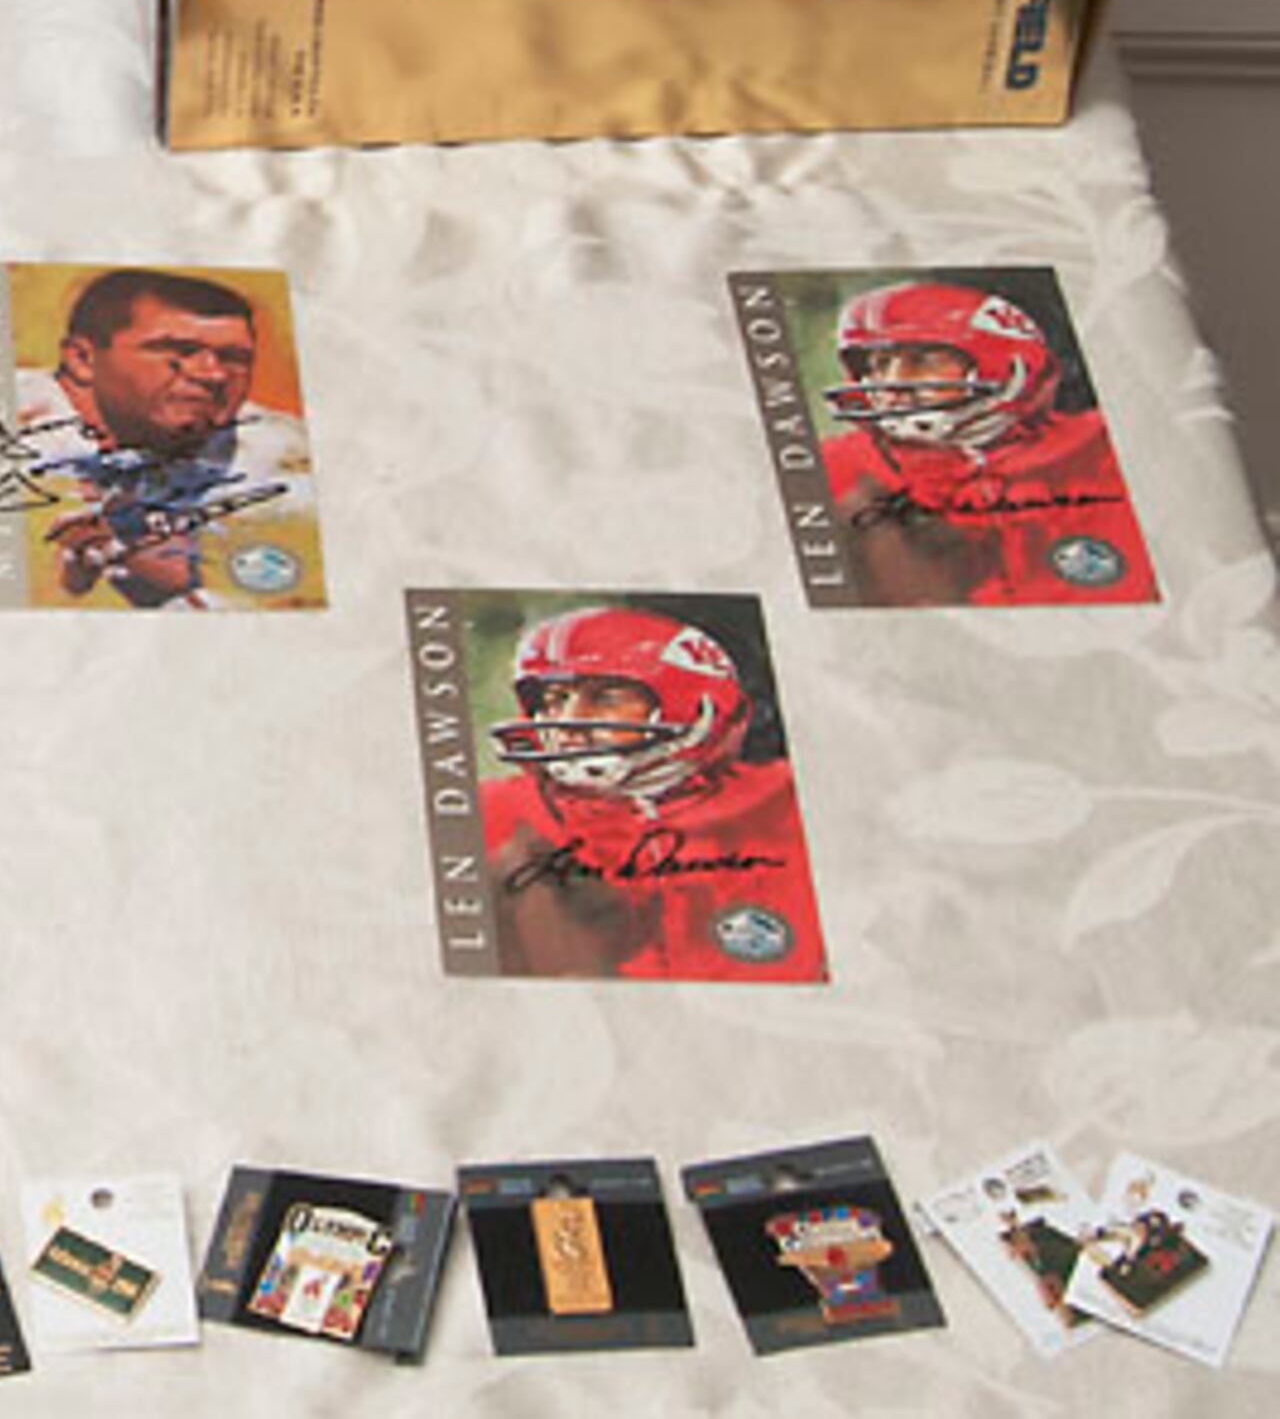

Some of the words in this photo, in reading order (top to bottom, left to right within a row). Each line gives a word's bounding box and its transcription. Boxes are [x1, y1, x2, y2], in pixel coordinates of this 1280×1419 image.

[743, 283, 817, 471] DAWSON
[793, 504, 843, 588] LEN
[414, 604, 472, 817] DAWSON
[442, 853, 486, 952] LEN
